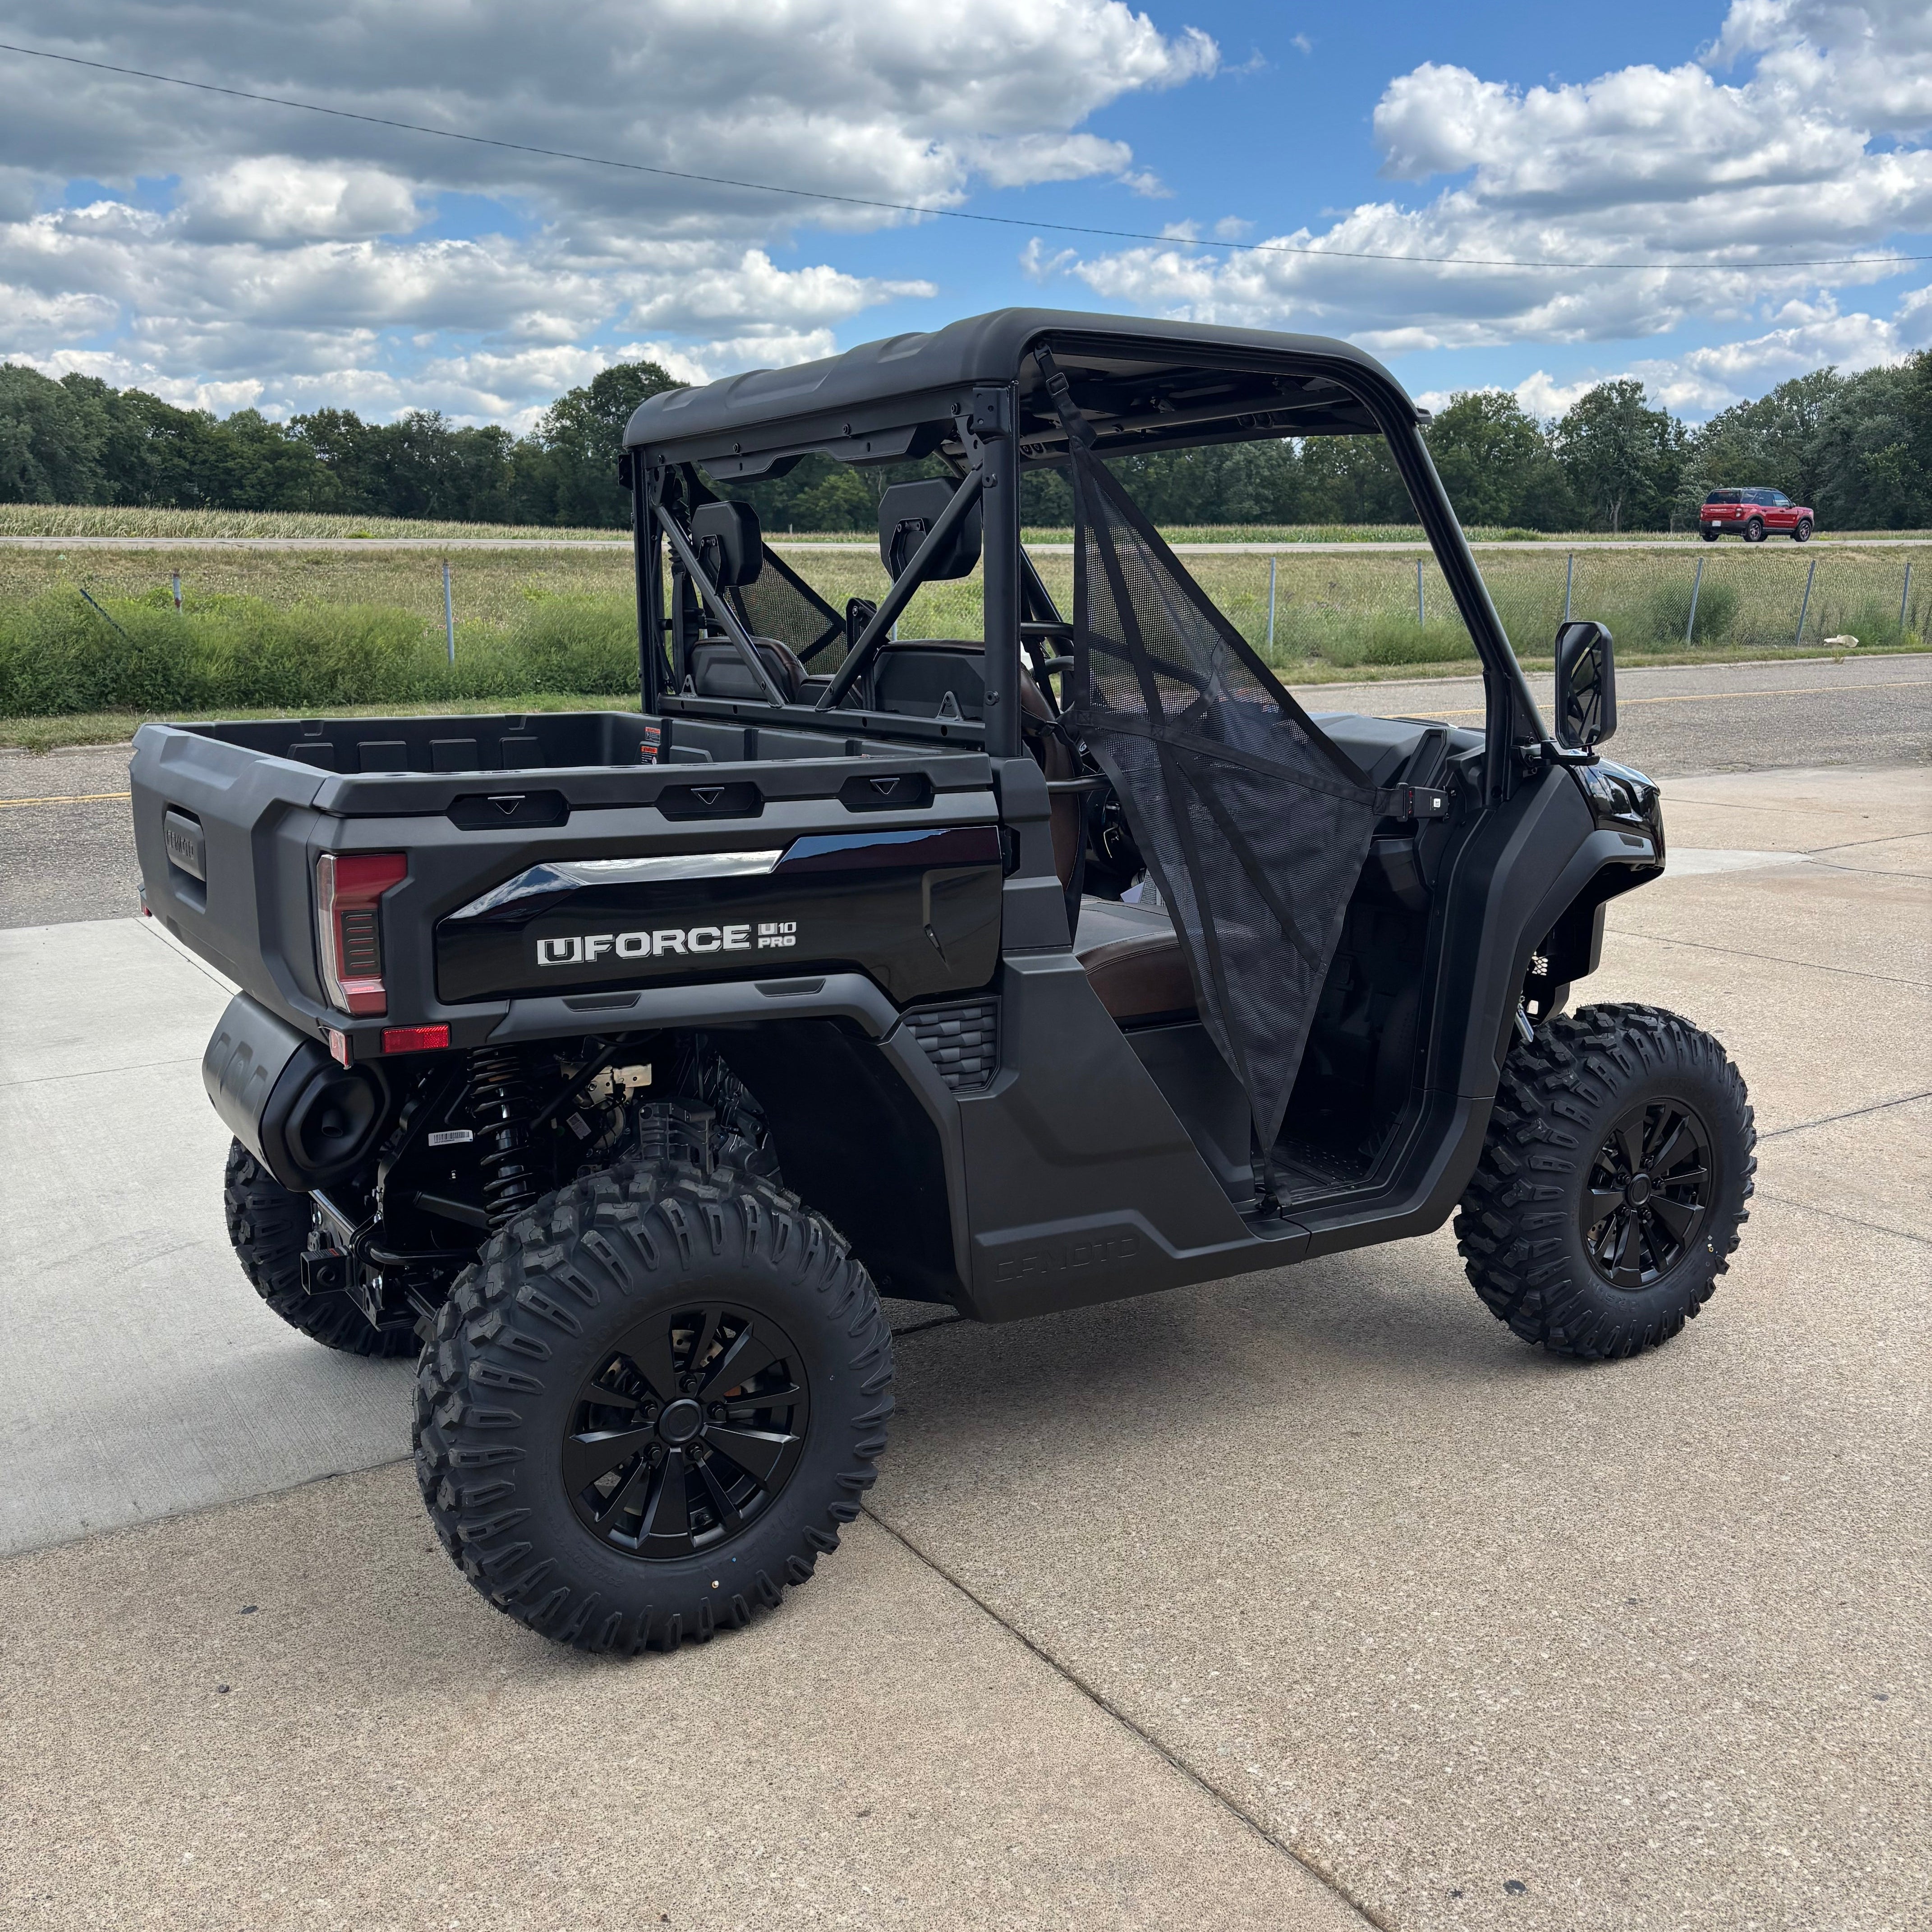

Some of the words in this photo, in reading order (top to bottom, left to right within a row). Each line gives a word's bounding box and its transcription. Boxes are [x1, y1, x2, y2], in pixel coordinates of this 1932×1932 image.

[758, 922, 796, 936] U10
[537, 925, 751, 966] UFORCE
[758, 935, 796, 949] PRO
